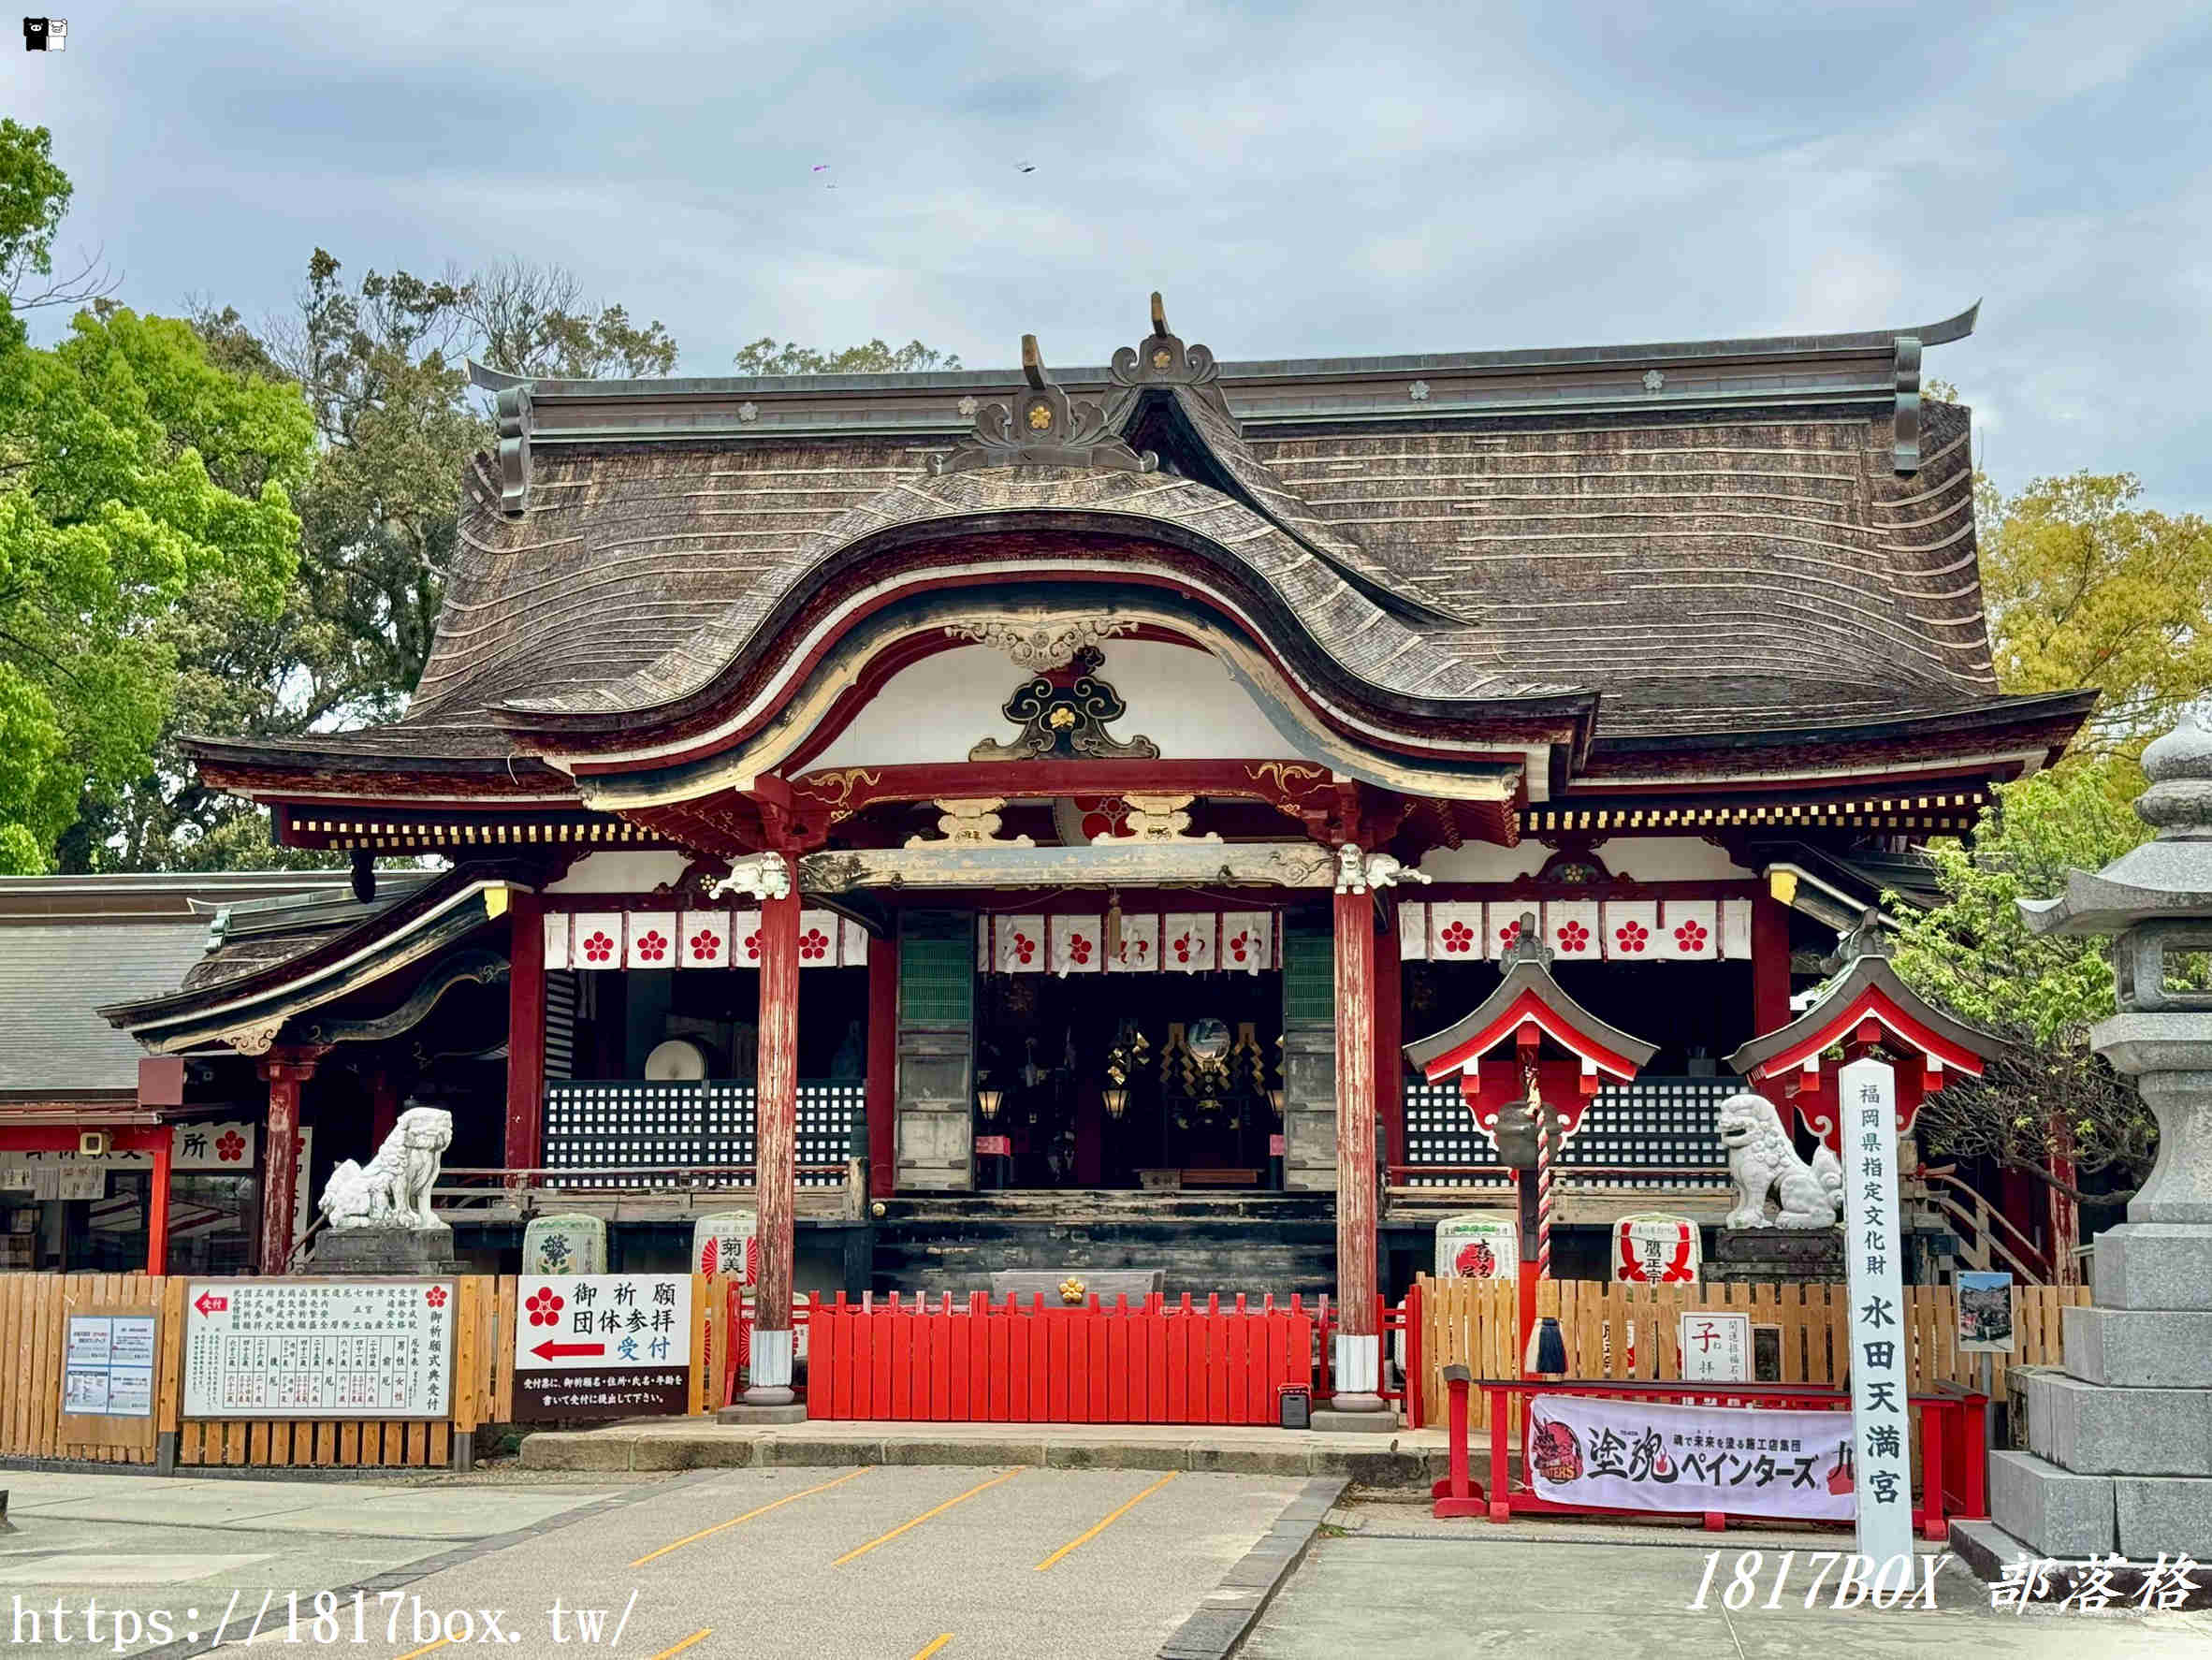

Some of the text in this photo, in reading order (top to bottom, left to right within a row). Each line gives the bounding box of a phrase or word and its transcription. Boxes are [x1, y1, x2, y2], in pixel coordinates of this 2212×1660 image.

[1859, 1084, 1886, 1275] 福岡県指定文化財
[573, 1282, 677, 1307] 御祈願
[573, 1309, 676, 1335] 団体参拝
[1692, 1322, 1721, 1353] 子
[427, 1311, 443, 1411] 御祈願式典受付
[618, 1335, 671, 1361] 受付
[1861, 1295, 1900, 1505] 水田天満宮
[1587, 1426, 1820, 1490] 塗魂 ペインターズ
[1673, 1434, 1801, 1453] 魂で未来を塗る施工店集団
